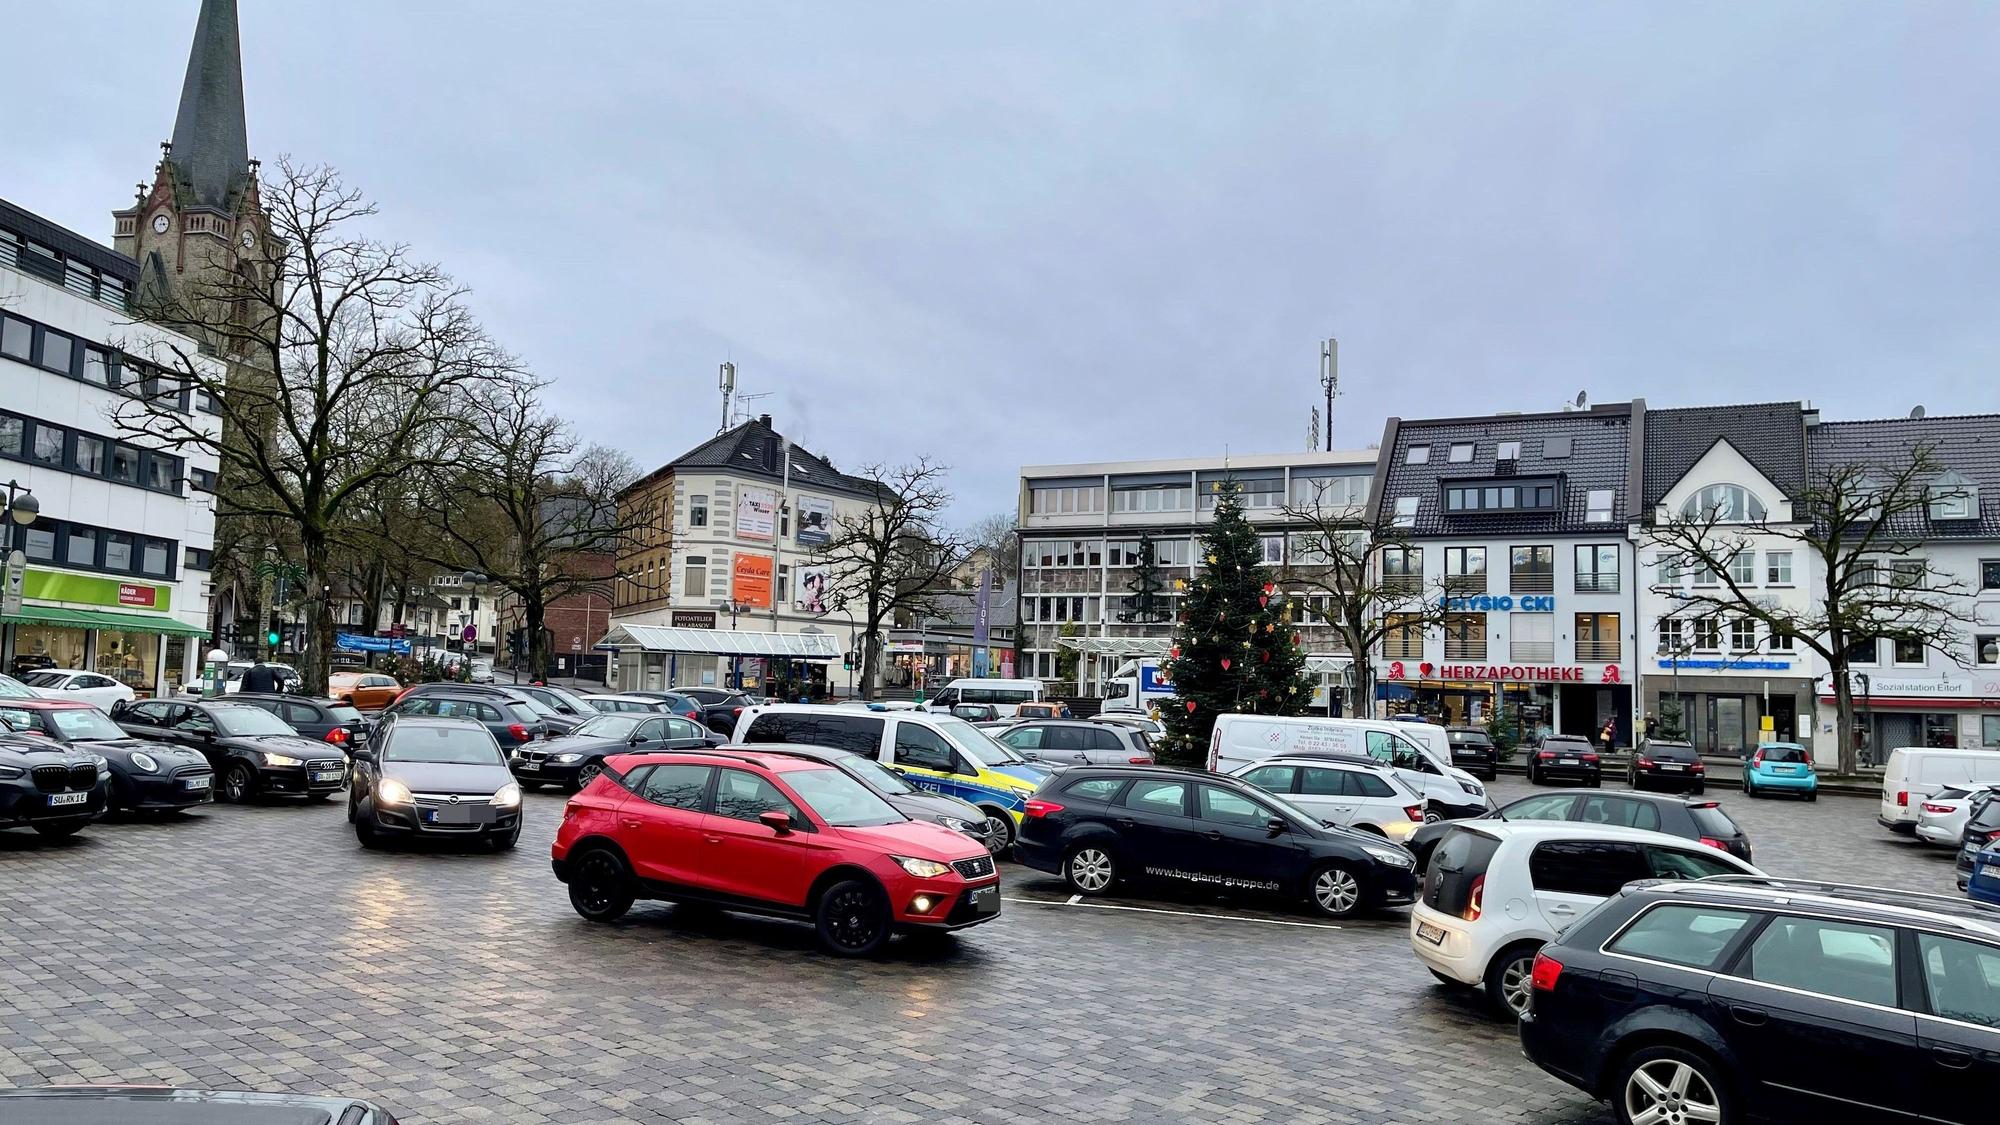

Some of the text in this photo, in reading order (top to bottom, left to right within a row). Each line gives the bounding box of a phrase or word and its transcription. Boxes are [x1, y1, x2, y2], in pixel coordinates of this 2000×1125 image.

[1440, 665, 1584, 681] HERZAPOTHEKE
[1876, 682, 1962, 692] Sozialstation Eitorf
[1145, 865, 1280, 891] www.bergland-gruppe.de
